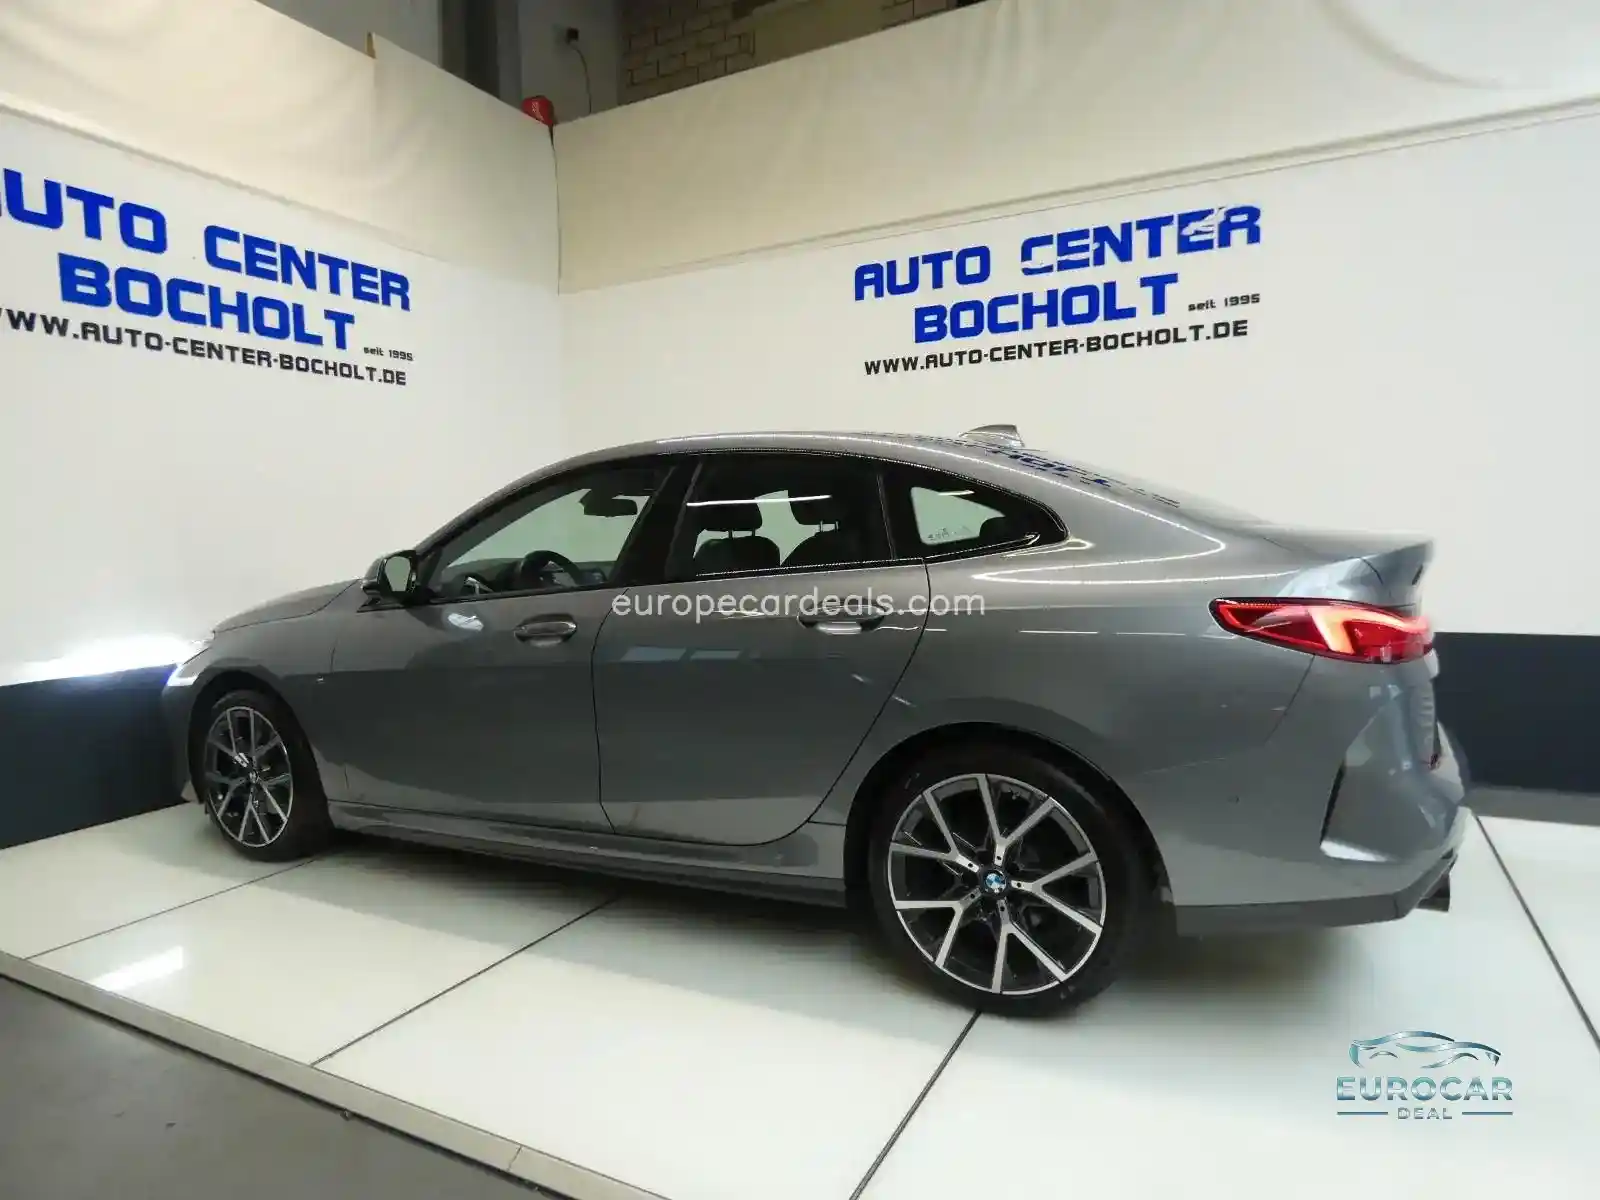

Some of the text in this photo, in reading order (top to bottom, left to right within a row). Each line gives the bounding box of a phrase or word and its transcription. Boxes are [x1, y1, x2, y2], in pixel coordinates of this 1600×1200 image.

[0, 168, 411, 312] UTO CENTER
[854, 204, 1262, 301] AUTO CENTER
[58, 252, 356, 351] BOCHOLT
[913, 272, 1179, 345] BOCHOLT
[1188, 293, 1260, 312] seit 1995
[0, 307, 406, 386] WW.AUTO-CENTER-BOCHOLT.DE
[363, 346, 413, 362] seit 1995
[864, 319, 1248, 376] WWW.AUTO-CENTER-BOCHOLT.DE
